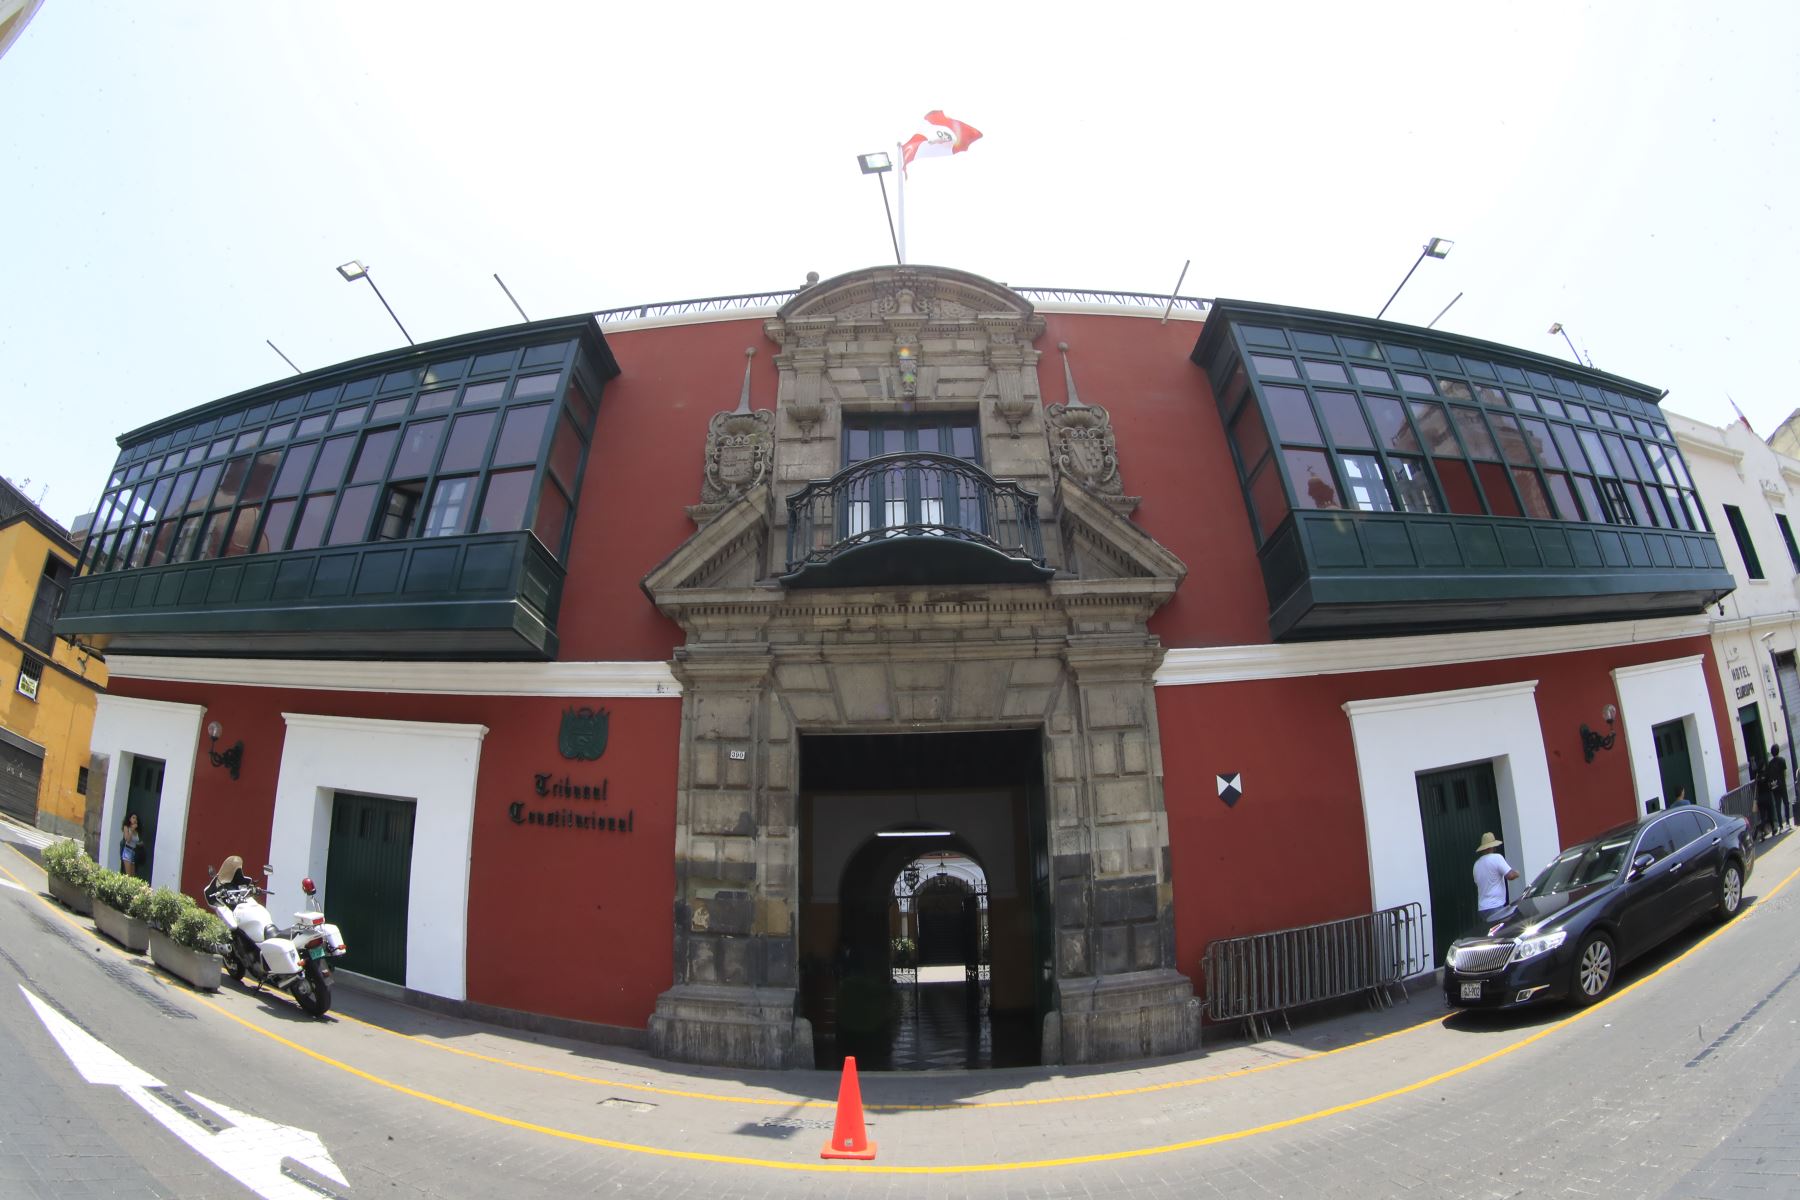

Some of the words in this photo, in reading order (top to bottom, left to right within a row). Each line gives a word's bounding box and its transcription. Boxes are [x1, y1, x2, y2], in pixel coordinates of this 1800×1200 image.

[1731, 665, 1750, 680] HOTEL
[1736, 682, 1755, 700] EUROPA
[534, 772, 609, 801] Tribunal
[509, 801, 634, 832] Constitucional
